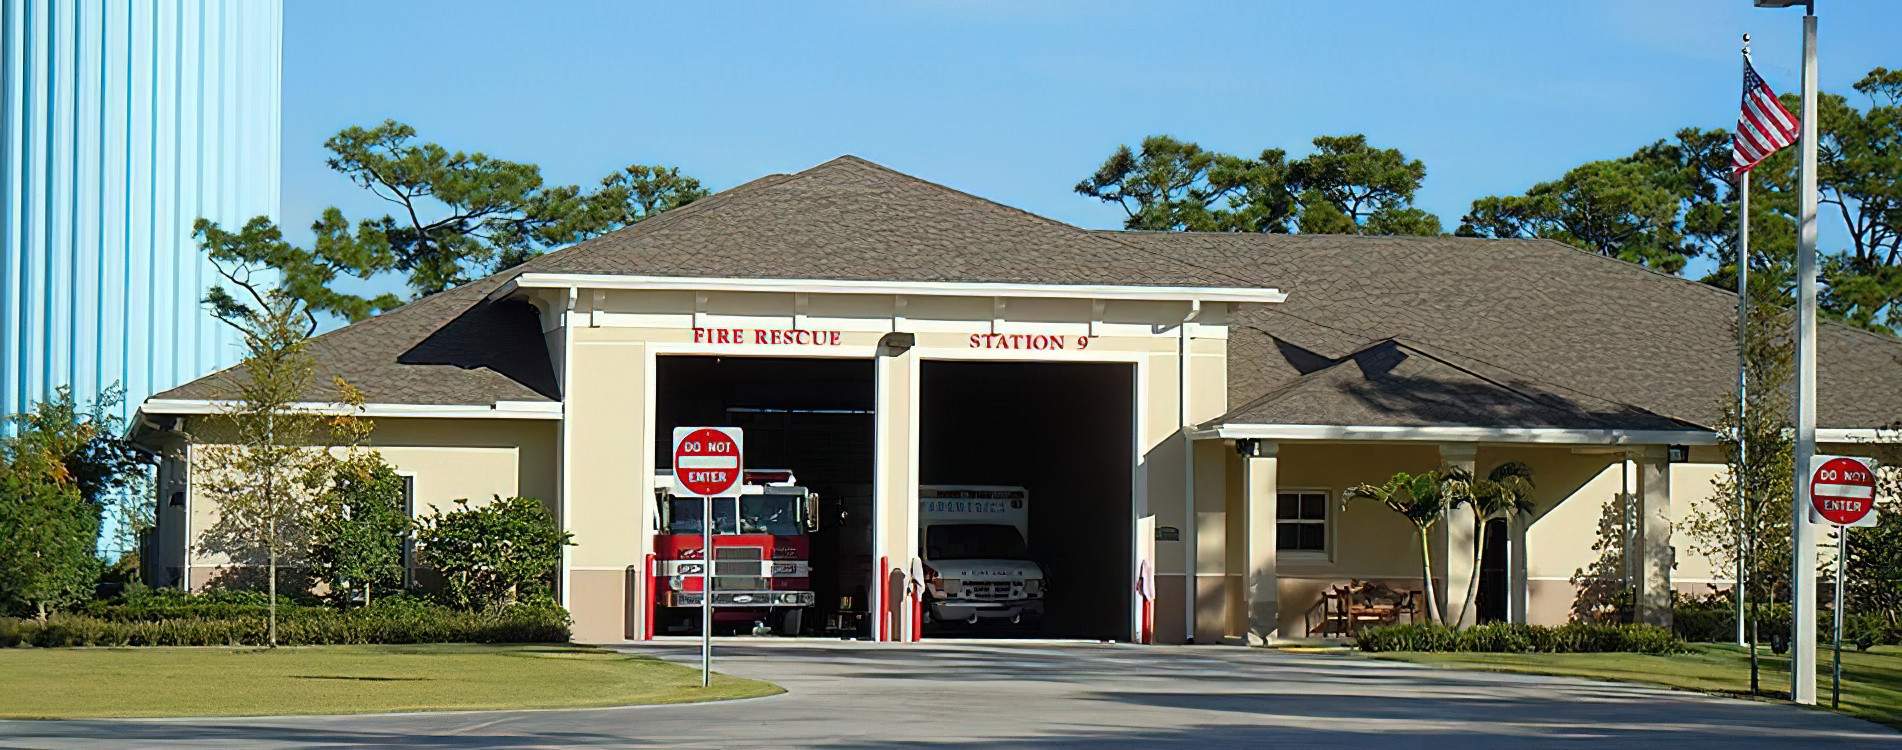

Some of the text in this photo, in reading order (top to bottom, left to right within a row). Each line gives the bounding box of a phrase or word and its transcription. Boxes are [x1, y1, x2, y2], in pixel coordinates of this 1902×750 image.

[693, 328, 841, 345] FIRE RESCUE
[970, 333, 1089, 350] STATION 9
[684, 441, 731, 453] DO NOT
[688, 471, 727, 483] ENTER
[1820, 469, 1866, 482] DO NOT
[1823, 499, 1862, 512] ENTER
